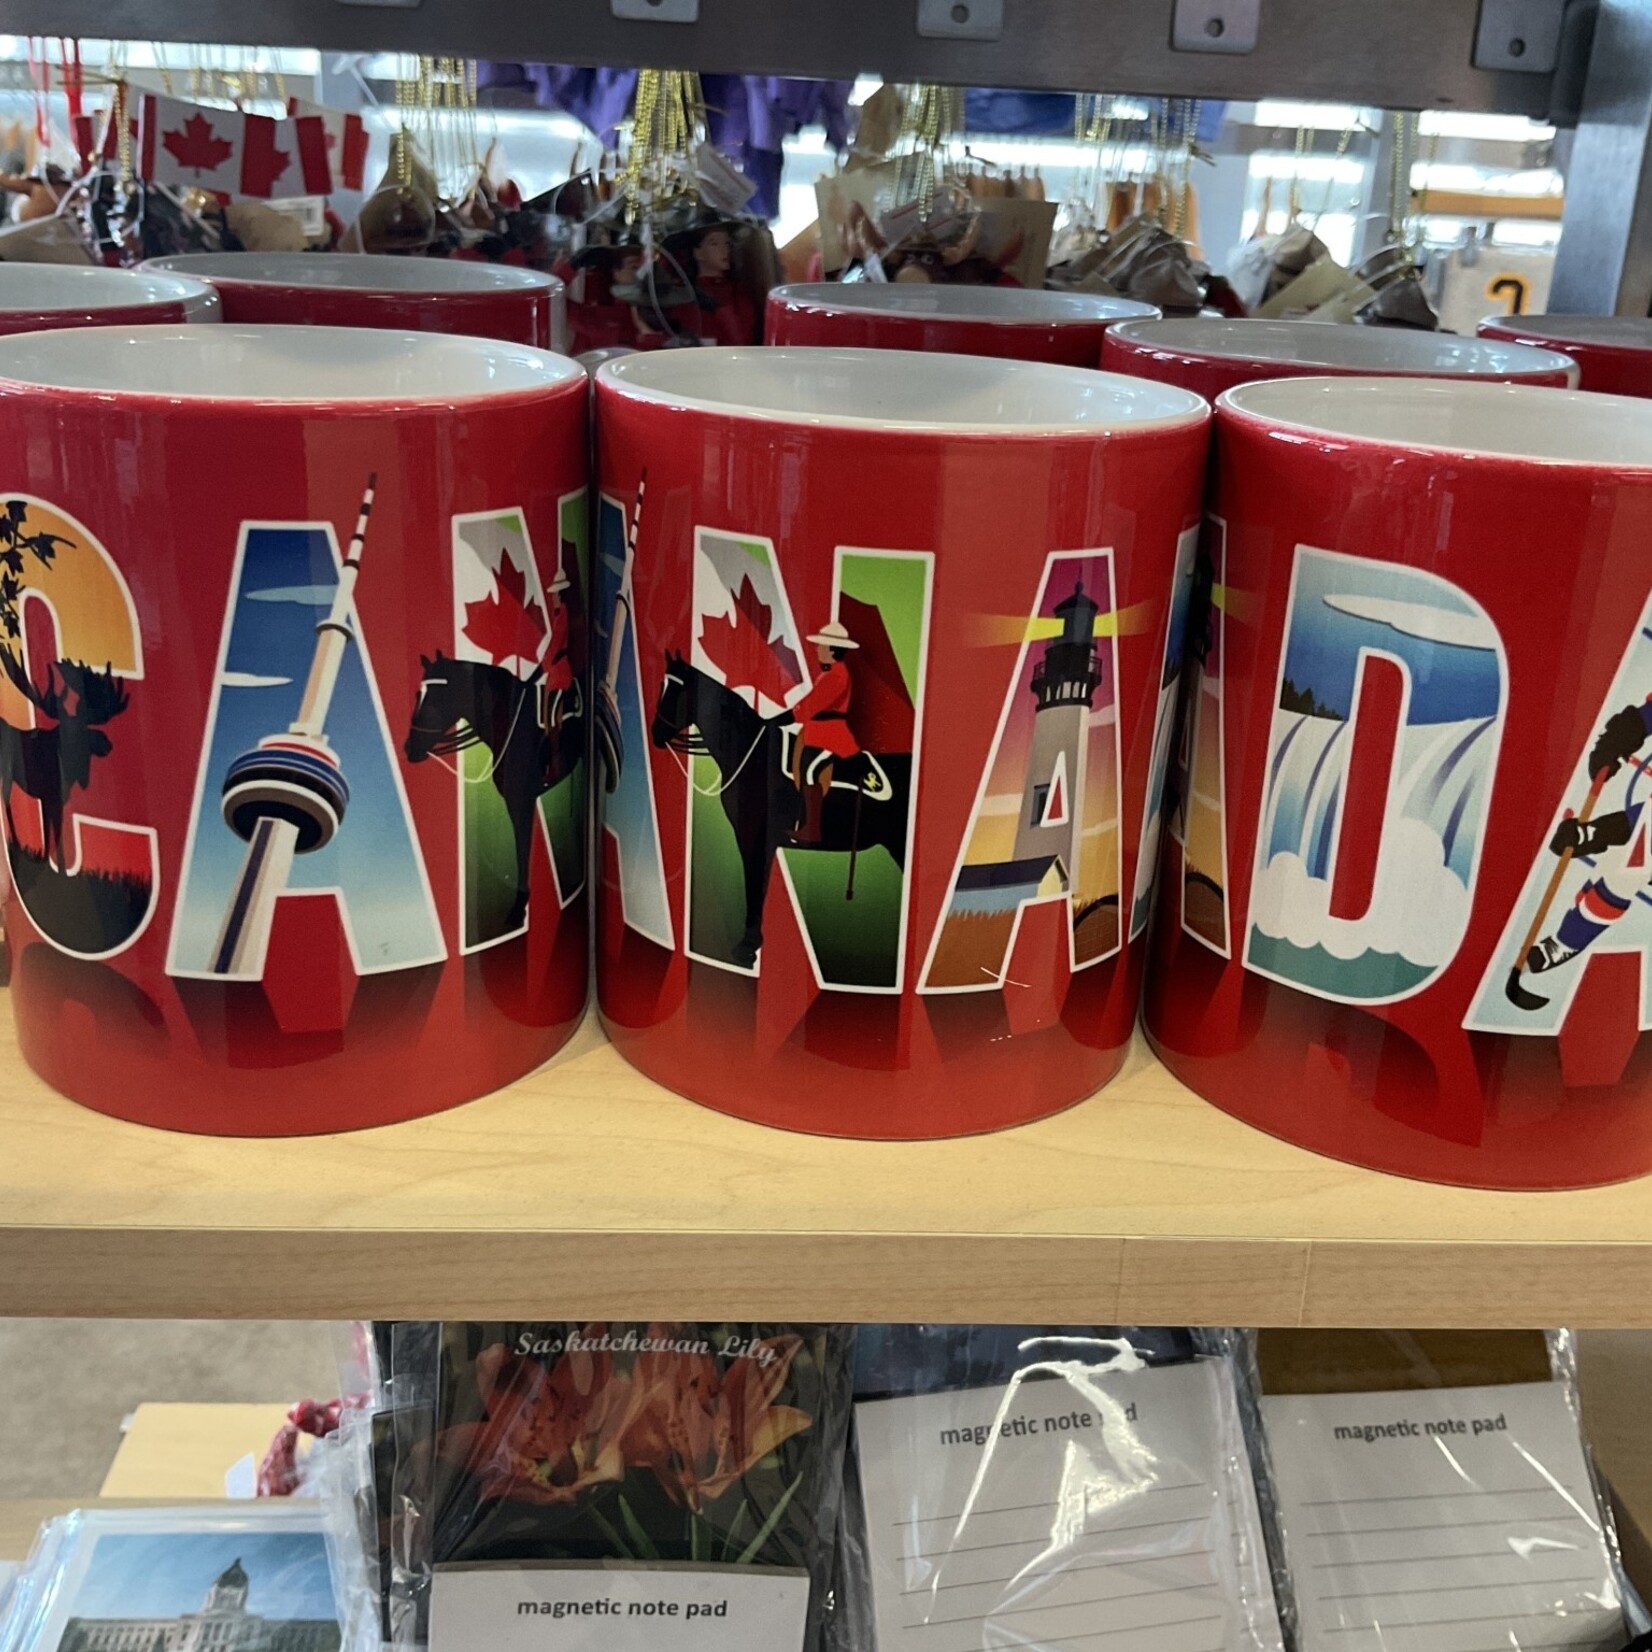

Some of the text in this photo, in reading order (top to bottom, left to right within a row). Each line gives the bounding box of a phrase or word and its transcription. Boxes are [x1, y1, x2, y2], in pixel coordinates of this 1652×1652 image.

[514, 1331, 778, 1368] Saskatchewan Lily
[1044, 1410, 1093, 1433] note
[1334, 1412, 1508, 1443] magnetic note pad
[517, 1598, 728, 1620] magnetic note pad
